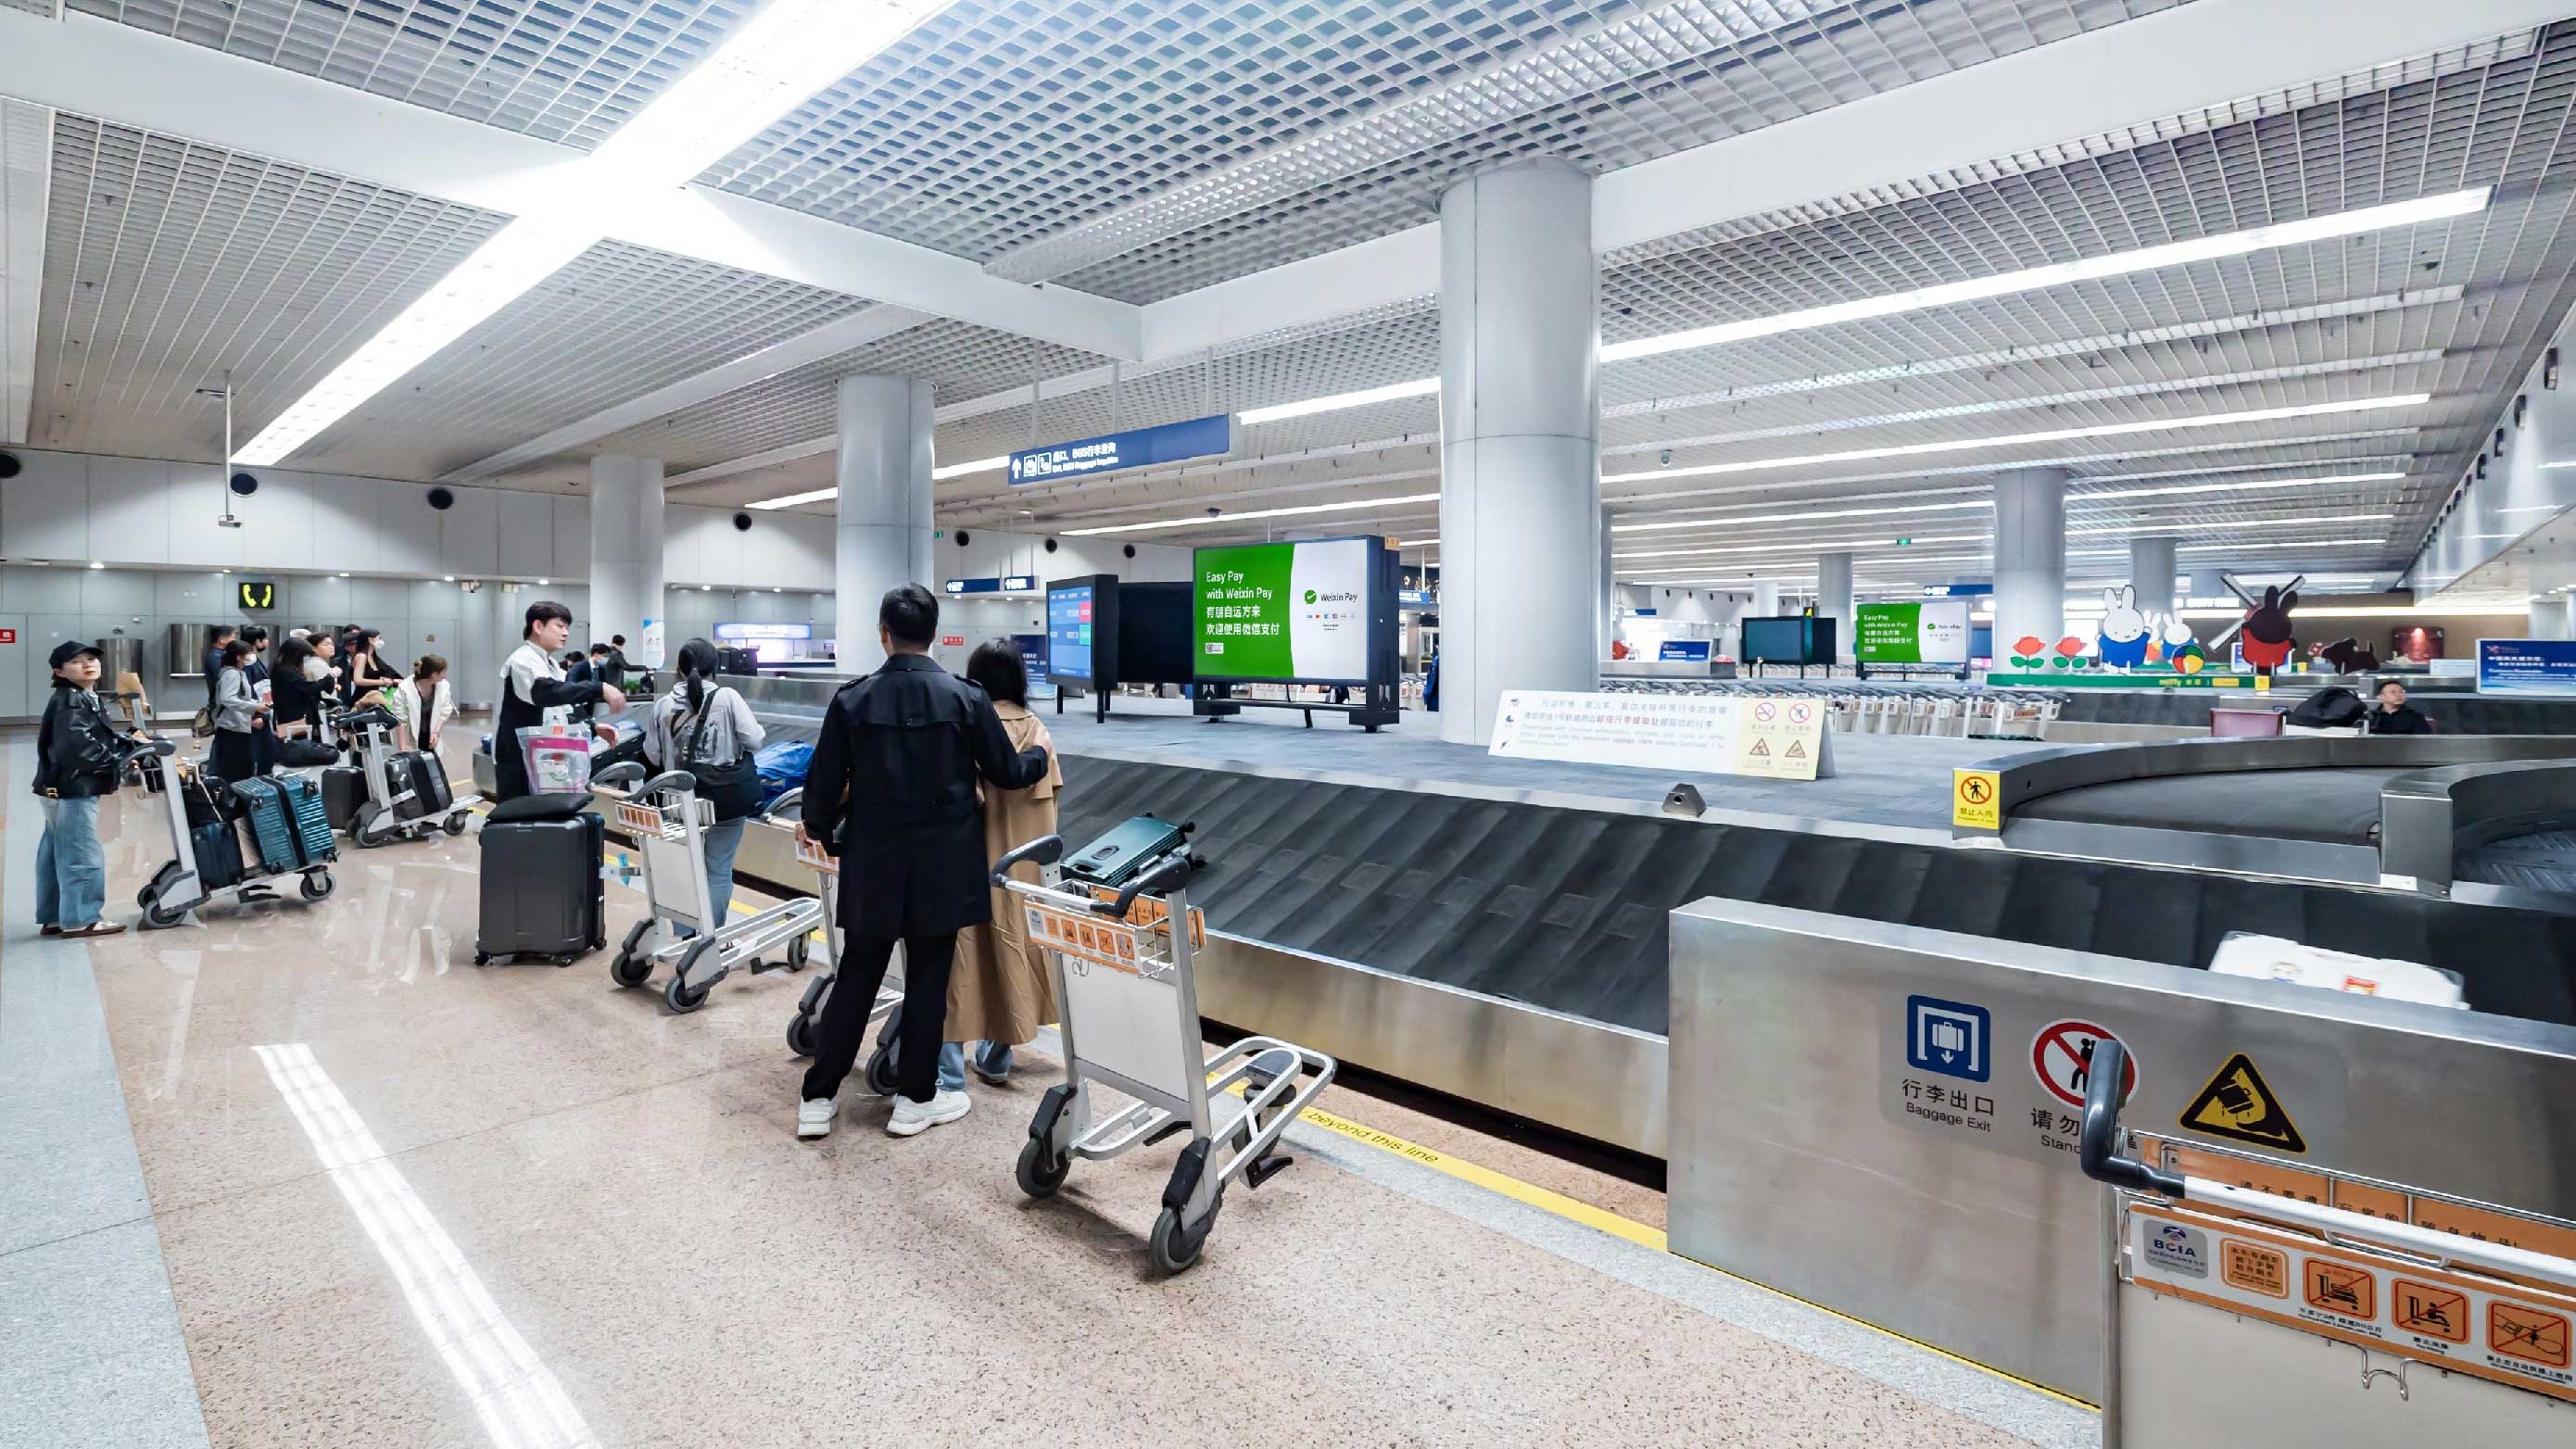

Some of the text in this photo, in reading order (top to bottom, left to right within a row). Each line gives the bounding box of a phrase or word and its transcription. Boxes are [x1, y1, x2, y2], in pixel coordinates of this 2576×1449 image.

[1206, 571, 1244, 585] Easy Pay
[1206, 586, 1273, 600] with Weixin Pay
[1320, 592, 1357, 603] Weixin Pay
[1206, 604, 1261, 619] 有朋自远方来
[1206, 623, 1280, 636] 欢迎使用微信支付
[1902, 1079, 1994, 1116] 行李出口
[1906, 1102, 1991, 1132] Baggage Exit
[1307, 1112, 1438, 1163] beyond this line
[2154, 1239, 2196, 1257] BCIA
